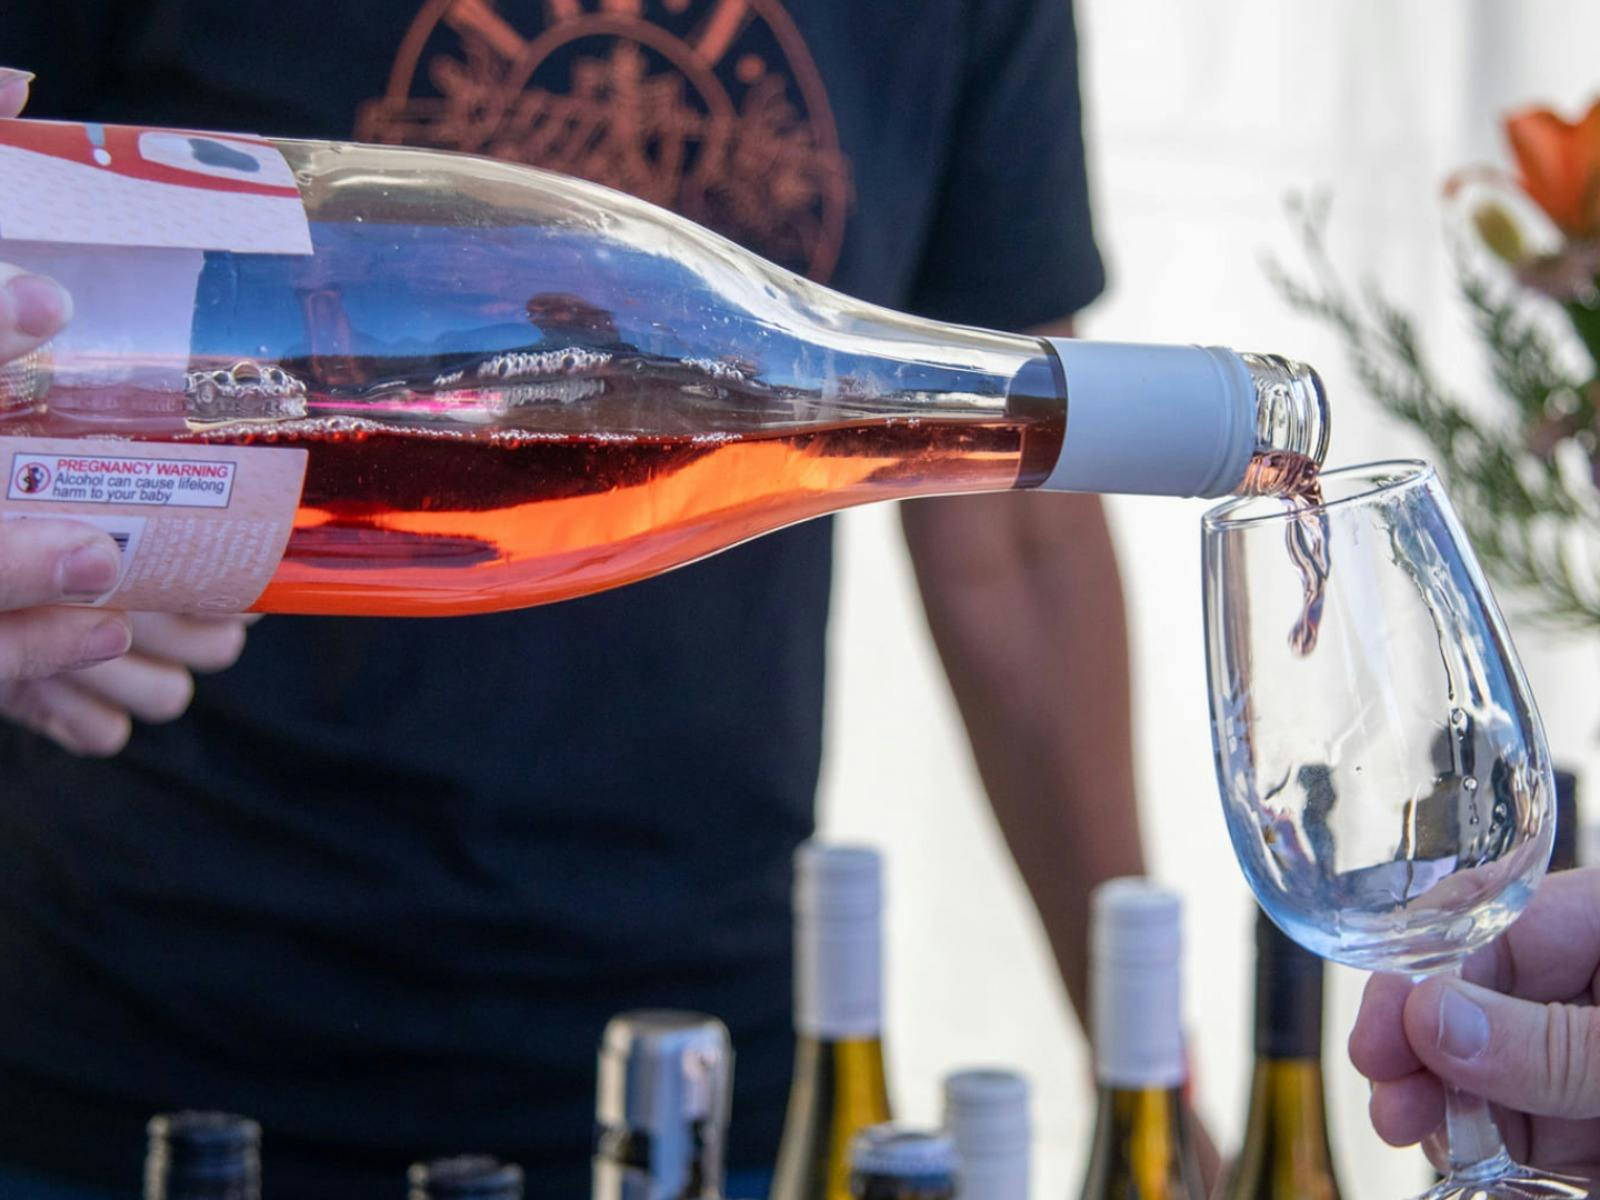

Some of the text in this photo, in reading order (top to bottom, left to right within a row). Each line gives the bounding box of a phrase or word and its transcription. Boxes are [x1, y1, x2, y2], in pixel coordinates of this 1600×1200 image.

[56, 459, 228, 479] PREGNANCY WARNING
[54, 472, 225, 494] Alcohol can cause lifelong
[52, 486, 172, 505] harm to your baby
